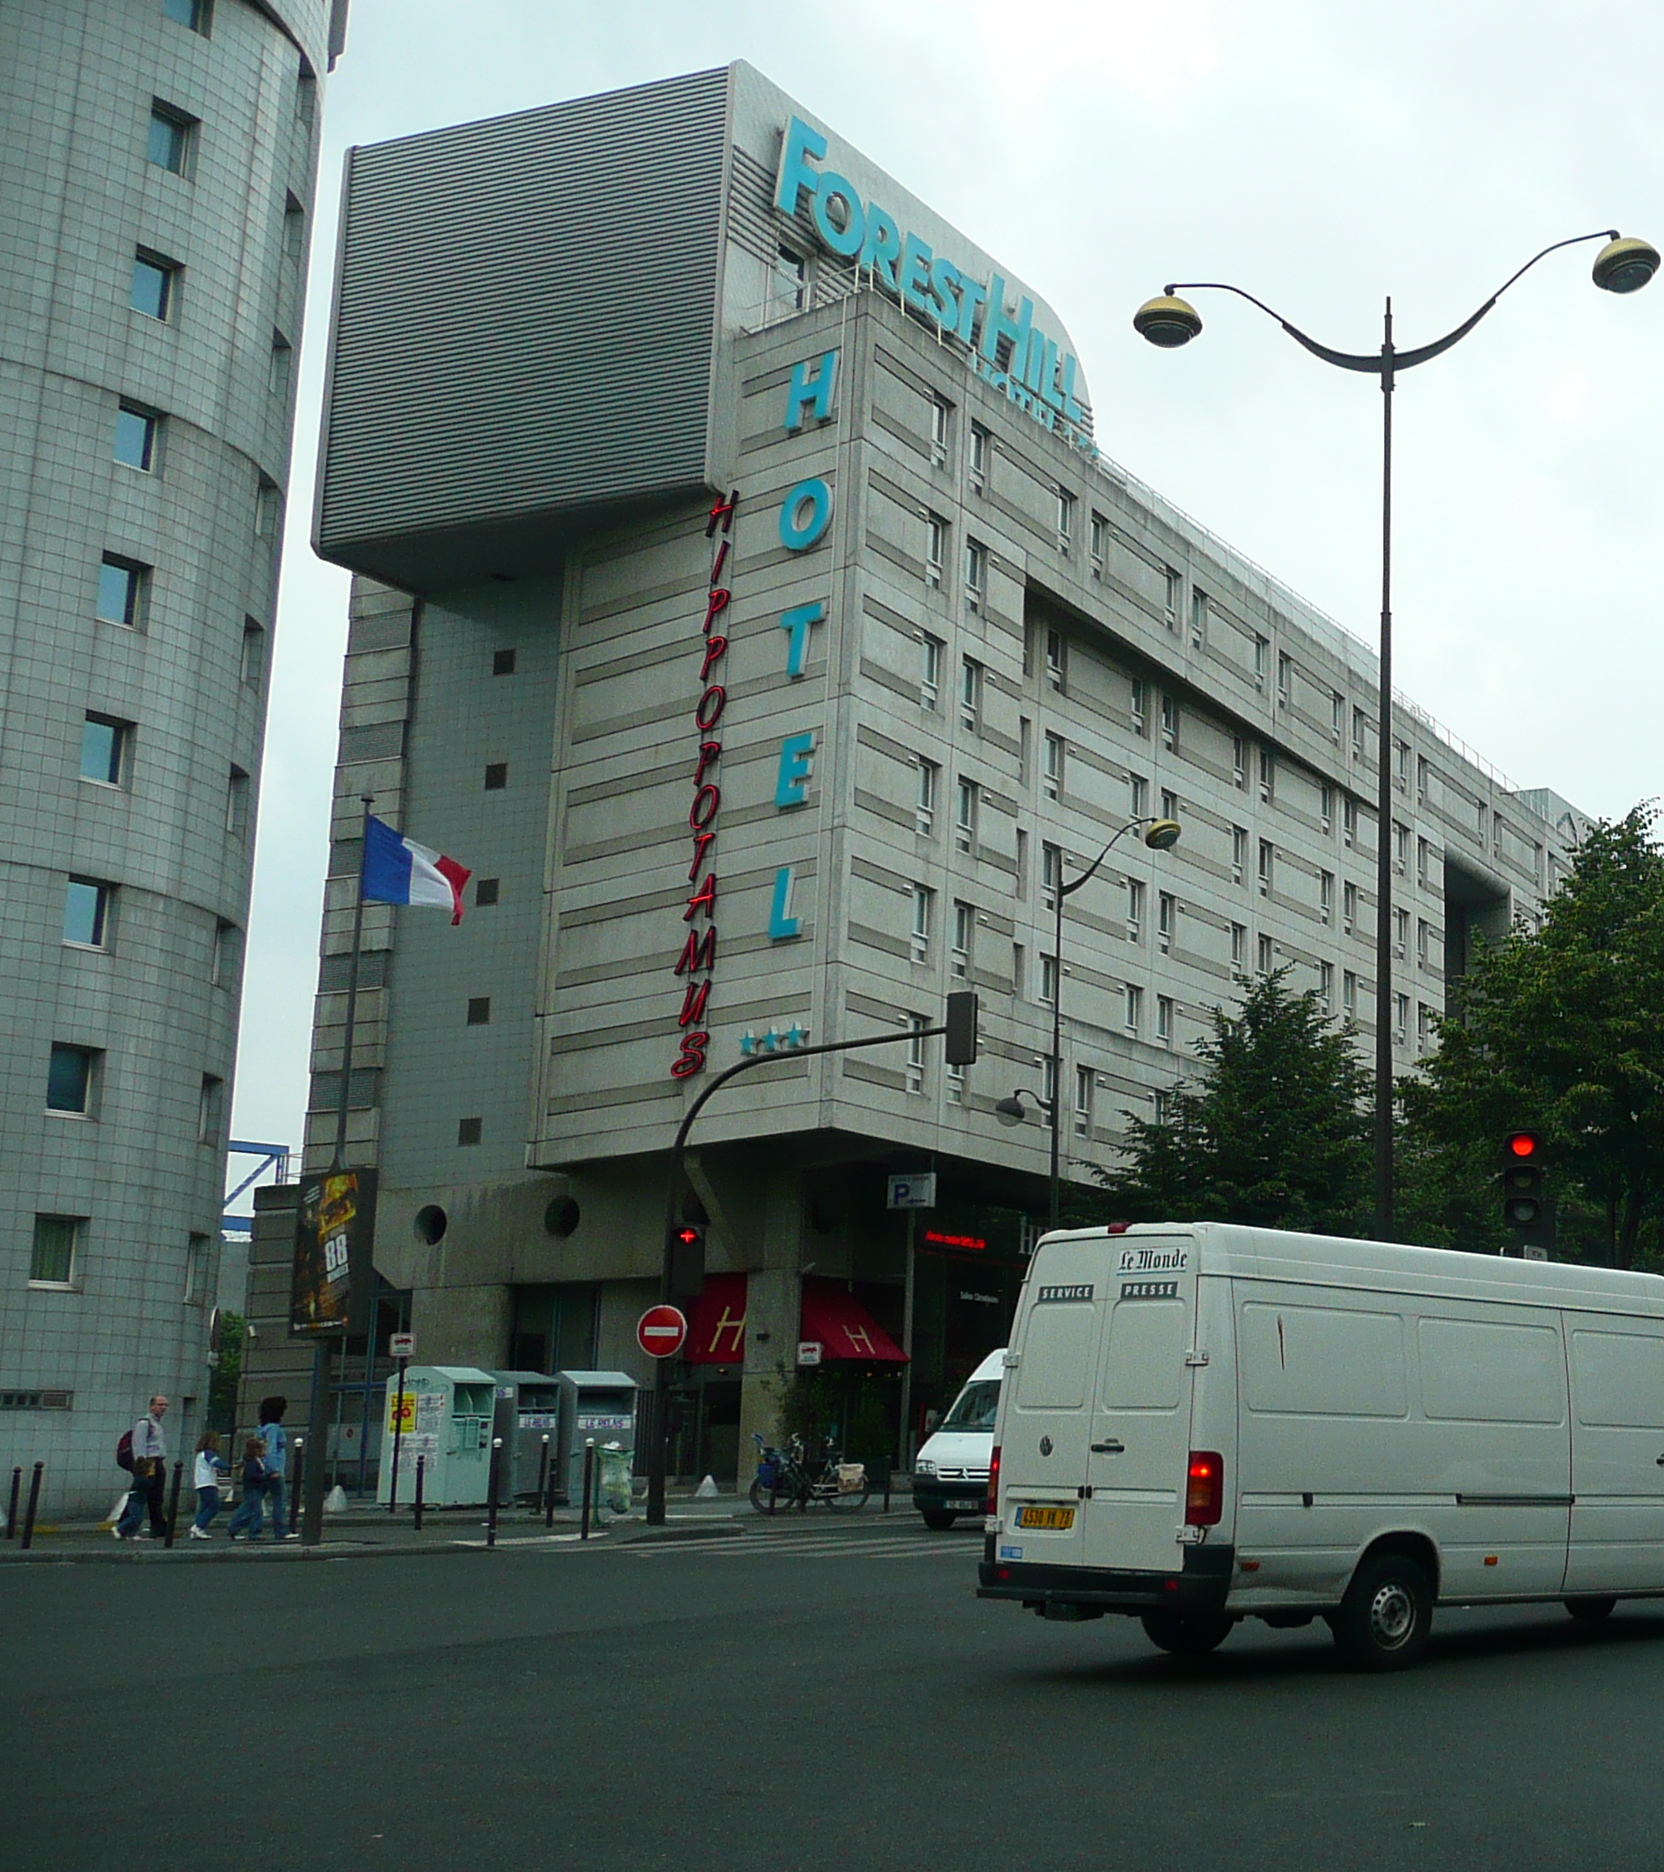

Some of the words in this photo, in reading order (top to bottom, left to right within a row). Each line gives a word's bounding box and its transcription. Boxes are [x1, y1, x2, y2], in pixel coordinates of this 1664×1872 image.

[773, 114, 986, 346] FOREST
[981, 272, 1082, 424] HILL
[767, 351, 838, 941] HOTEL
[670, 489, 739, 1078] HIPPOPOTAMUS
[894, 1184, 910, 1205] P
[325, 1234, 349, 1273] 88
[1119, 1251, 1134, 1270] Le
[1136, 1248, 1188, 1270] Monde
[1042, 1287, 1090, 1299] SERVICE
[1125, 1284, 1173, 1296] PRESSE
